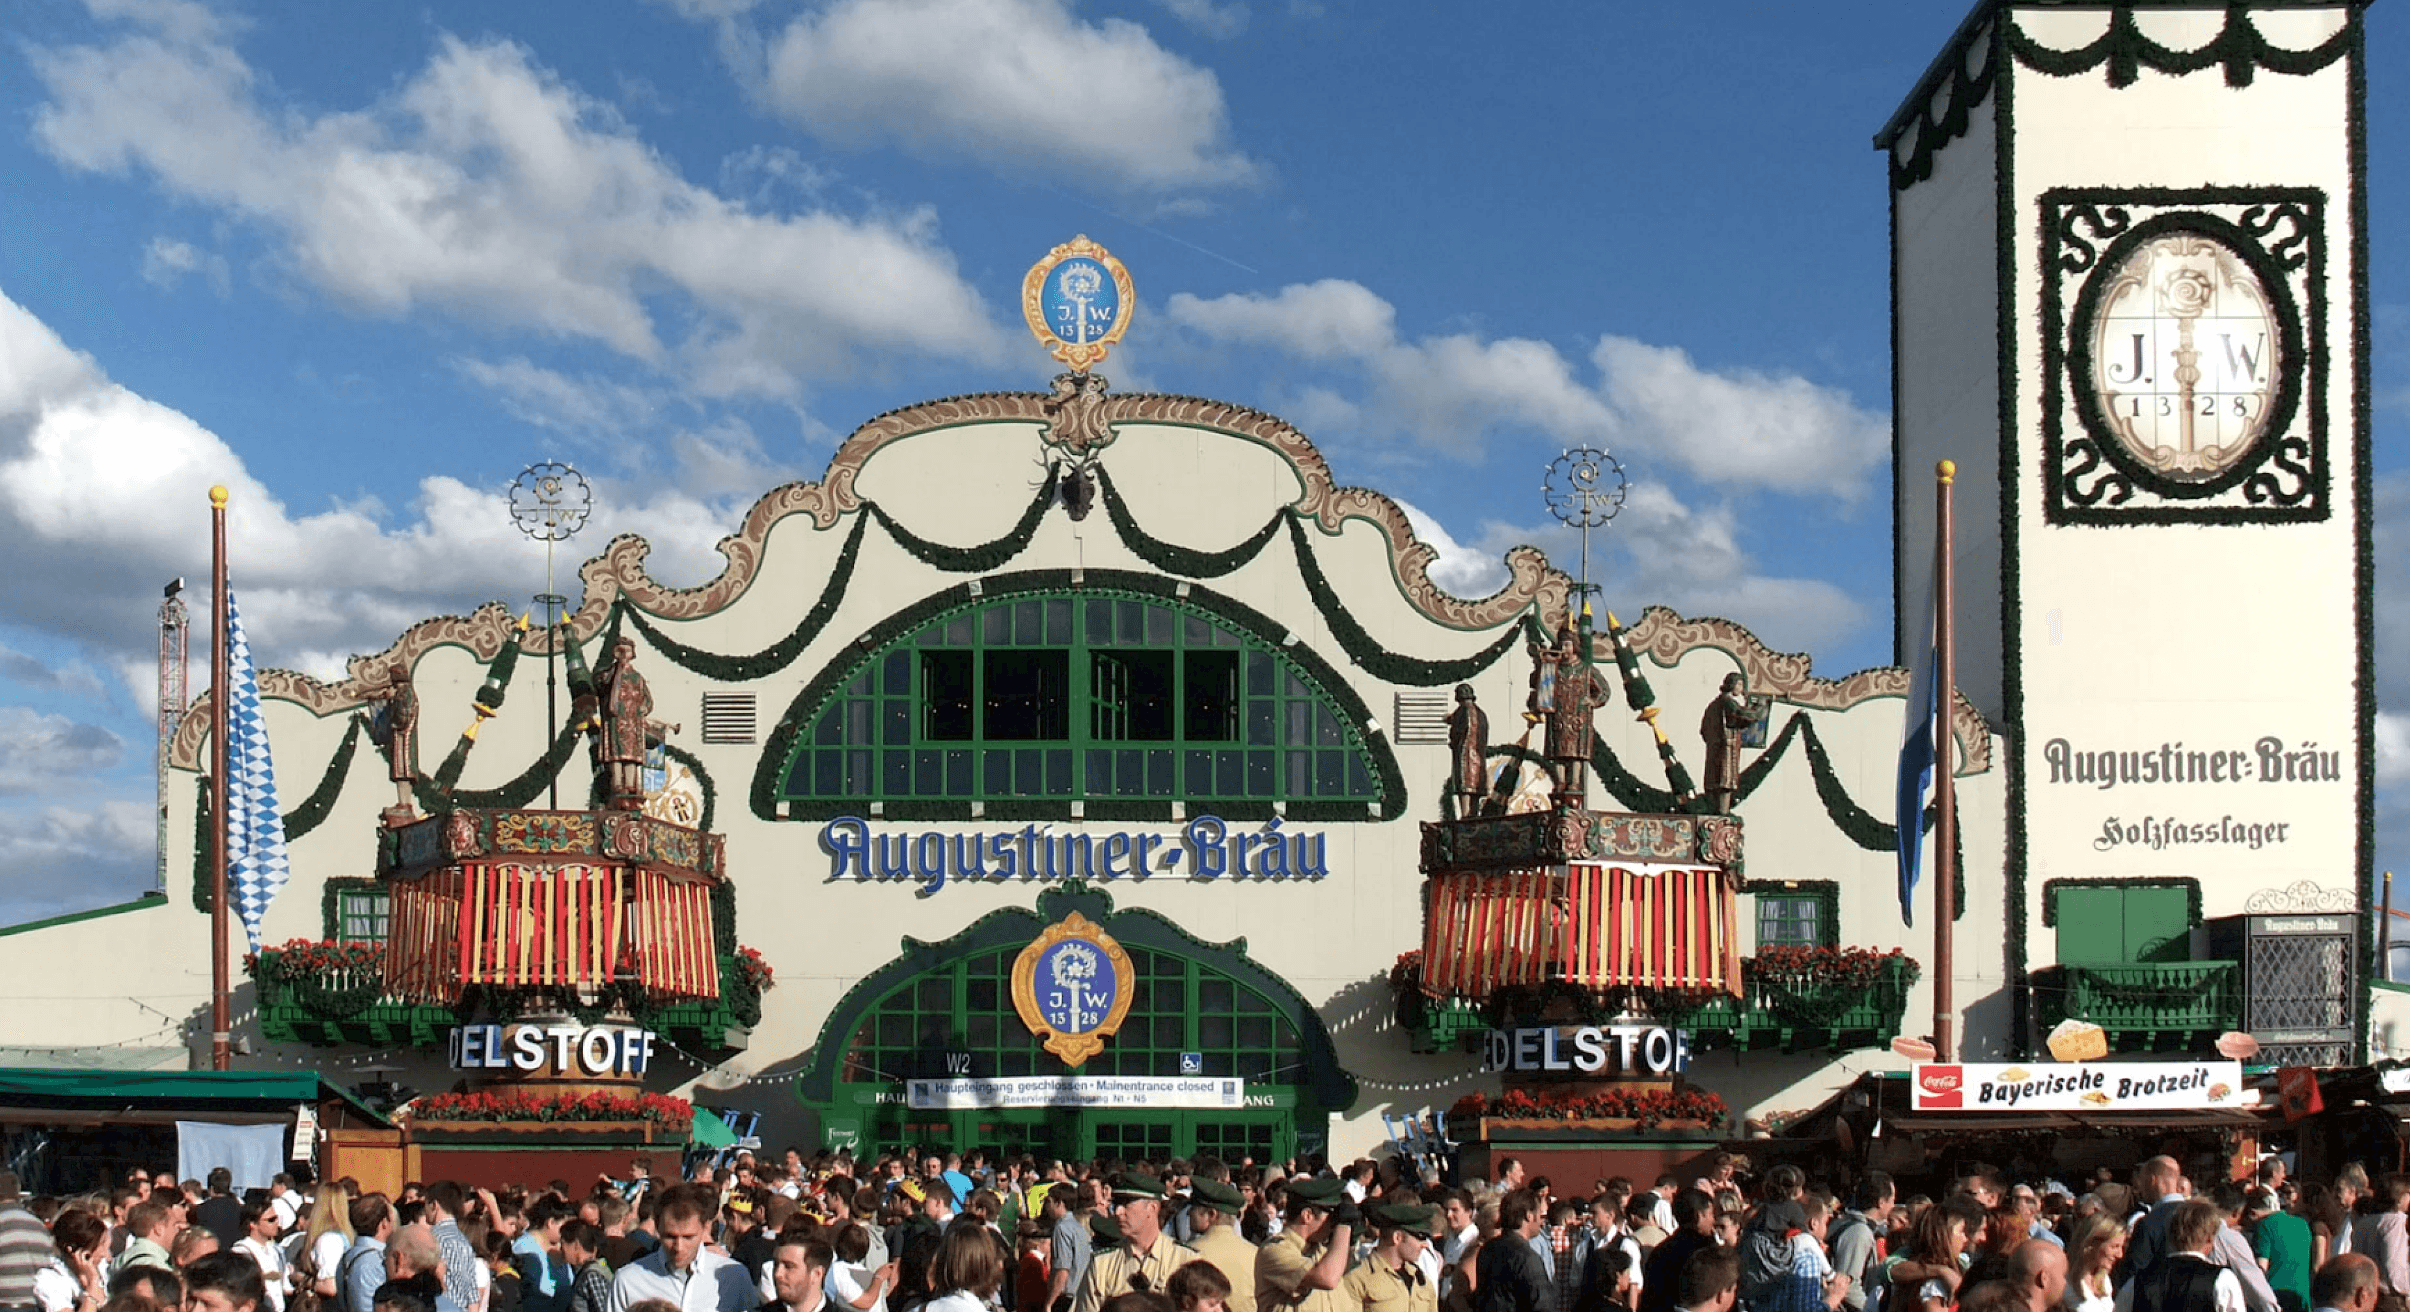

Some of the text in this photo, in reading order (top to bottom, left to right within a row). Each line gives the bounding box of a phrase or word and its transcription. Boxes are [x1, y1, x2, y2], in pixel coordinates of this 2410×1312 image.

[2108, 333, 2266, 384] J. W.
[2093, 815, 2290, 852] Holzfasslager
[946, 1052, 971, 1074] W2
[935, 1080, 1214, 1094] Haupteingang geschlossen Mainentrance closed
[1979, 1068, 2105, 1107] Bayerische
[2116, 1067, 2209, 1099] Brotzeit
